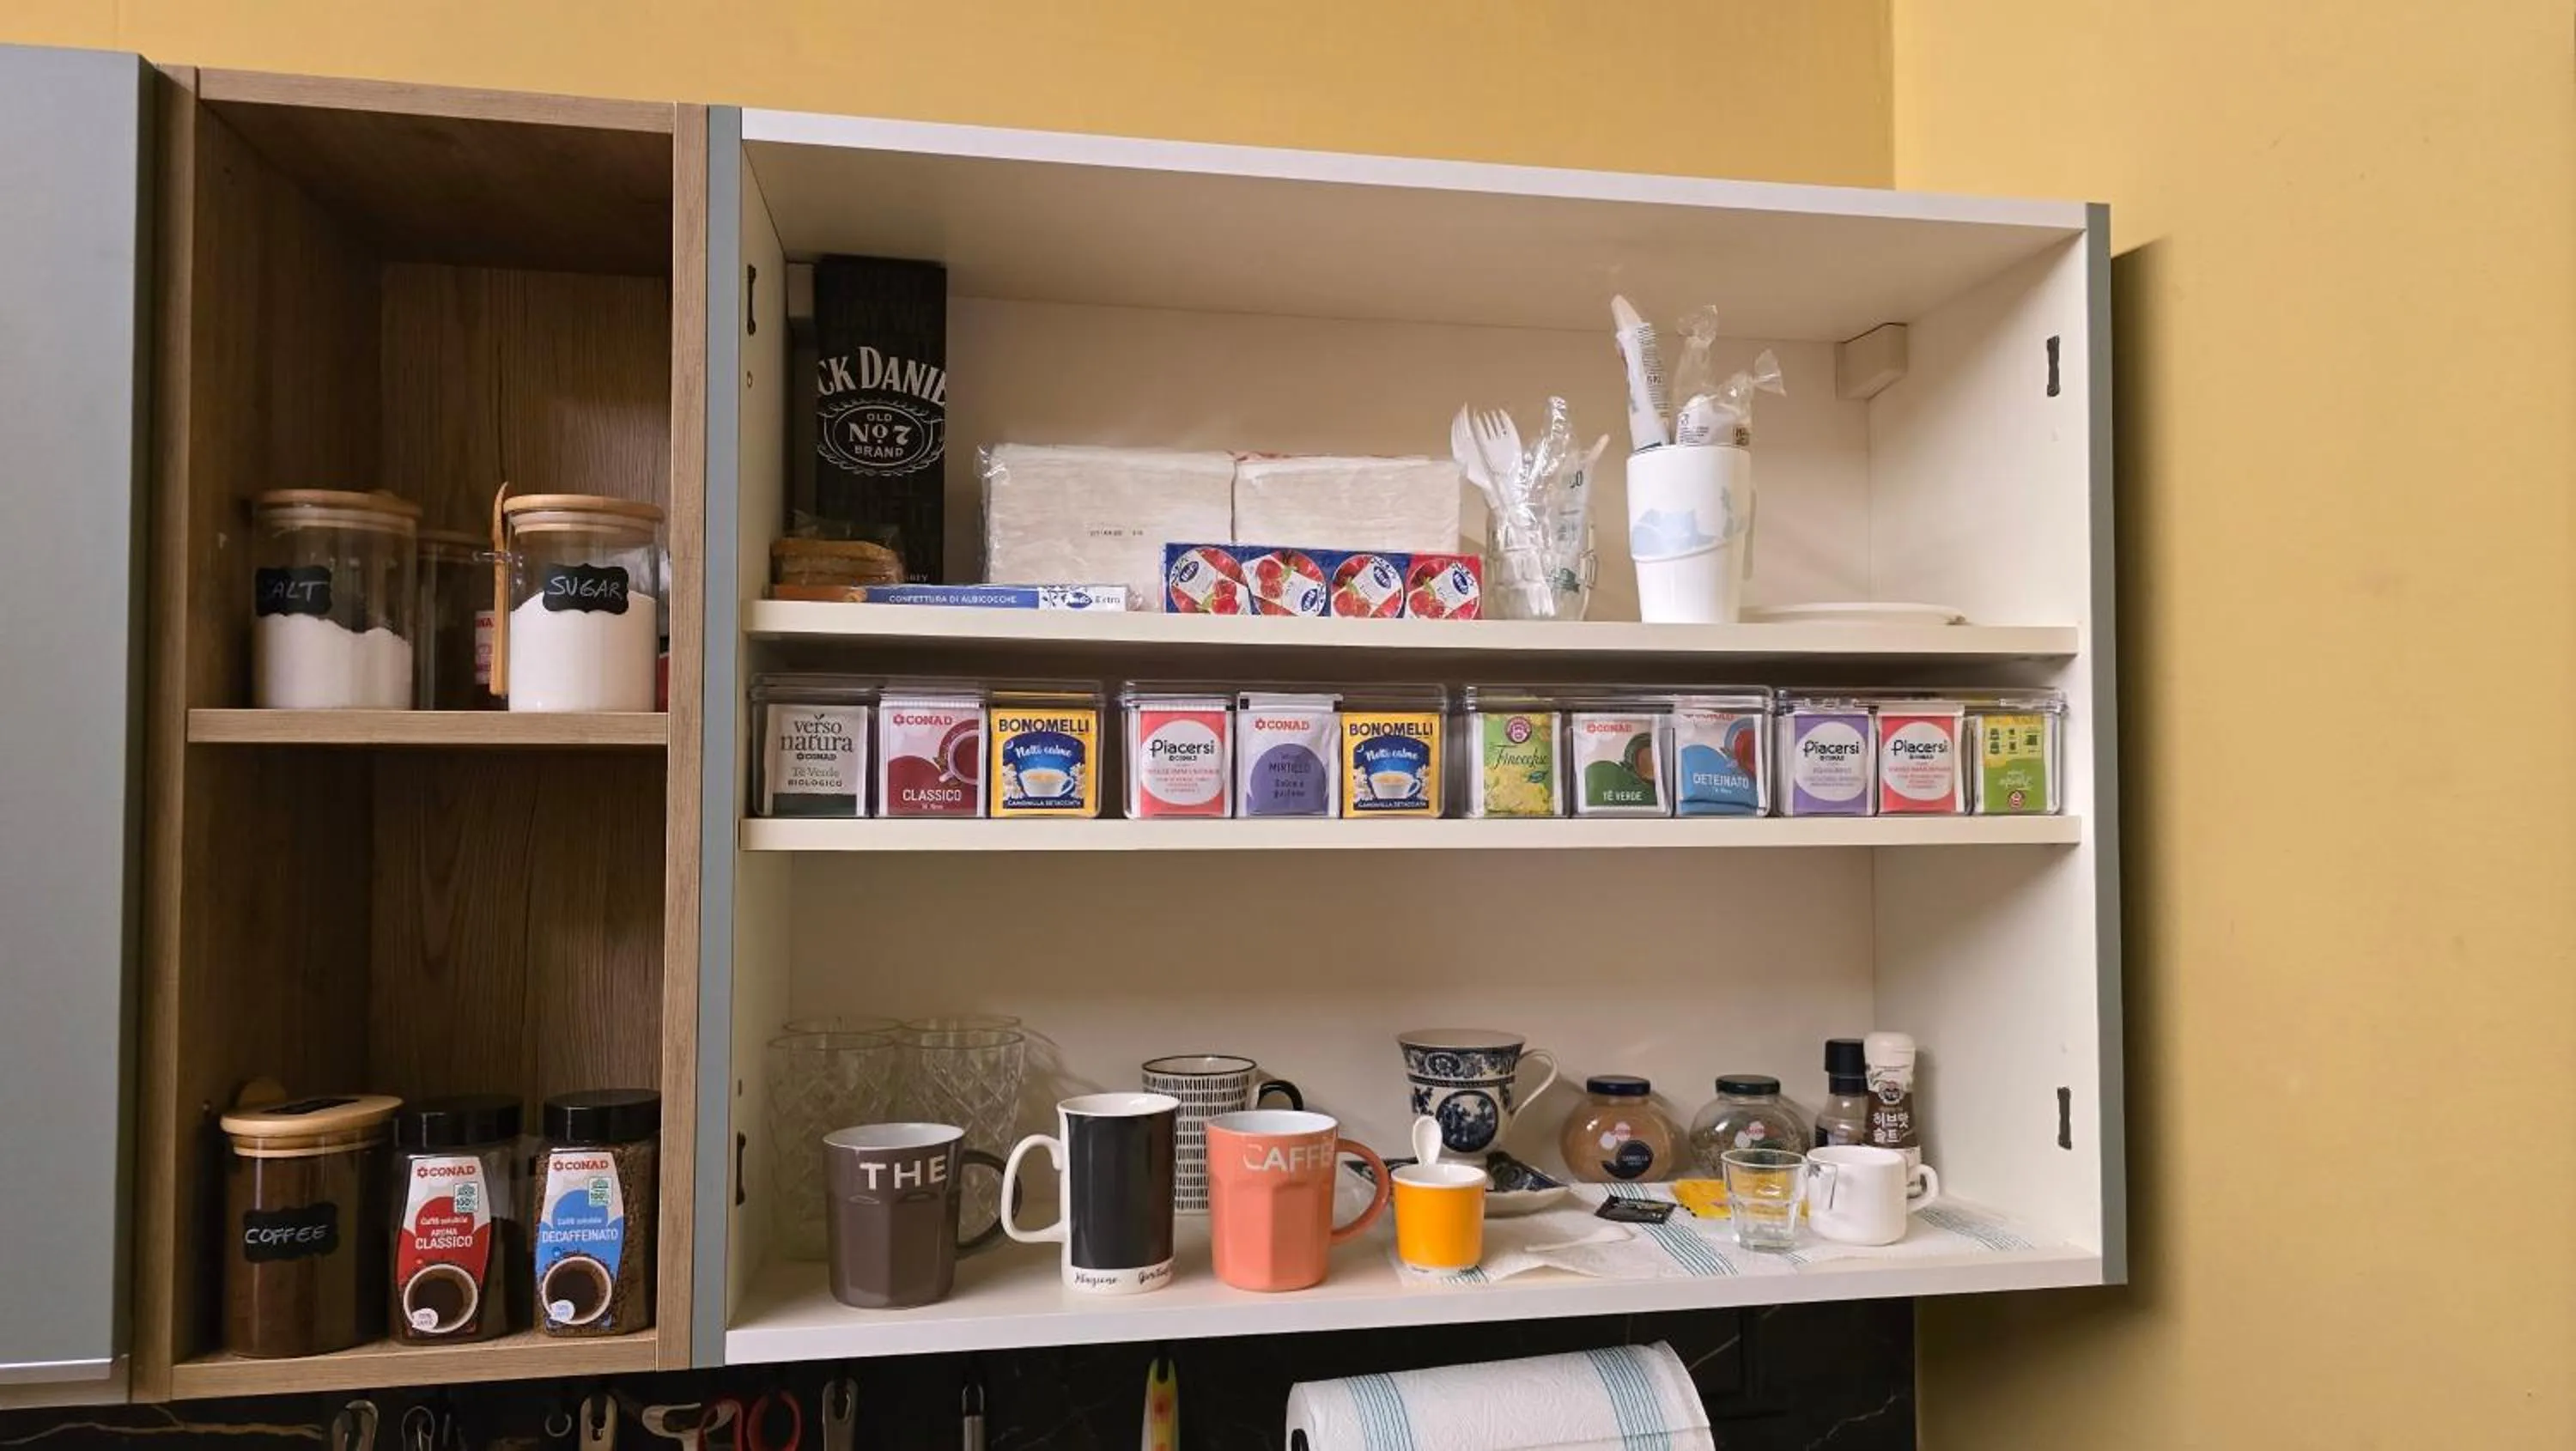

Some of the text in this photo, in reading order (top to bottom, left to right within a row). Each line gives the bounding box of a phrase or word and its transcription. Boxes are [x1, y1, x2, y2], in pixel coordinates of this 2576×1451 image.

[866, 413, 892, 422] OLD
[854, 446, 903, 458] BRAND
[546, 575, 623, 601] SUGAR
[949, 595, 960, 604] DI
[794, 721, 842, 734] verso
[906, 715, 953, 726] CONAD
[999, 719, 1090, 732] BONOMELLI
[1267, 720, 1310, 731] CONAD
[1349, 722, 1433, 736] BONOMELLI
[781, 734, 854, 753] natura
[1149, 739, 1214, 757] Piacersi
[1803, 739, 1860, 757] Piacersi
[1891, 739, 1947, 756] Piacersi
[787, 778, 842, 787] BIOLOGICO
[1692, 773, 1749, 789] DETEINATO
[902, 789, 963, 801] CLASSICO
[1873, 1112, 1909, 1129] 허브맛
[429, 1165, 476, 1177] CONAD
[564, 1160, 609, 1170] CONAD
[860, 1155, 947, 1190] THE
[245, 1224, 329, 1245] COFFEE
[542, 1229, 618, 1243] DECAFFEINATO
[415, 1236, 473, 1250] CLASSICO
